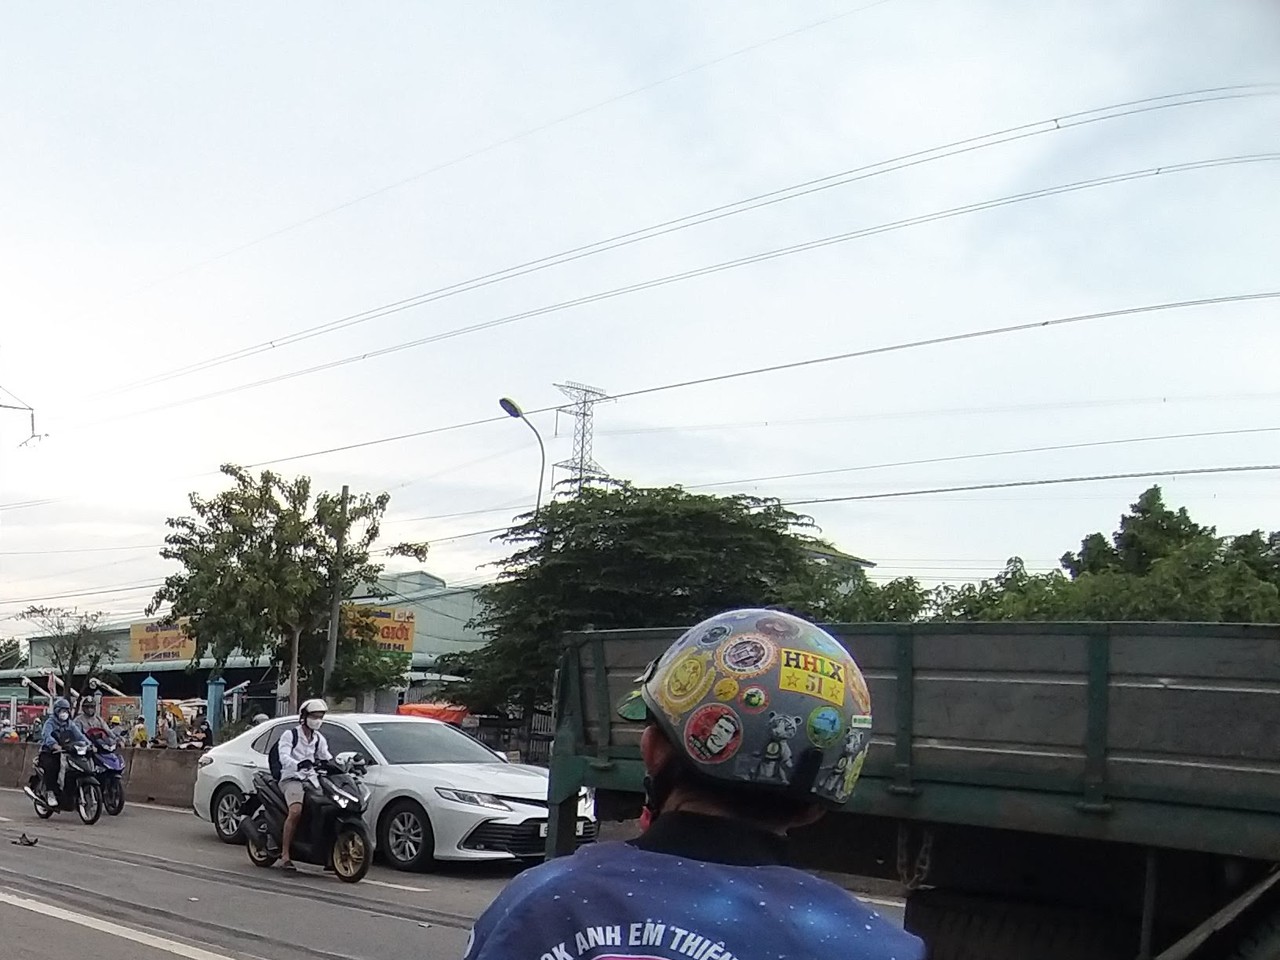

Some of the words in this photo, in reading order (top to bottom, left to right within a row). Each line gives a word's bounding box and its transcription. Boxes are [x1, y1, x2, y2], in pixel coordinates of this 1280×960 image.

[783, 651, 844, 684] HHLX
[574, 924, 622, 956] ANH
[628, 922, 666, 946] EM
